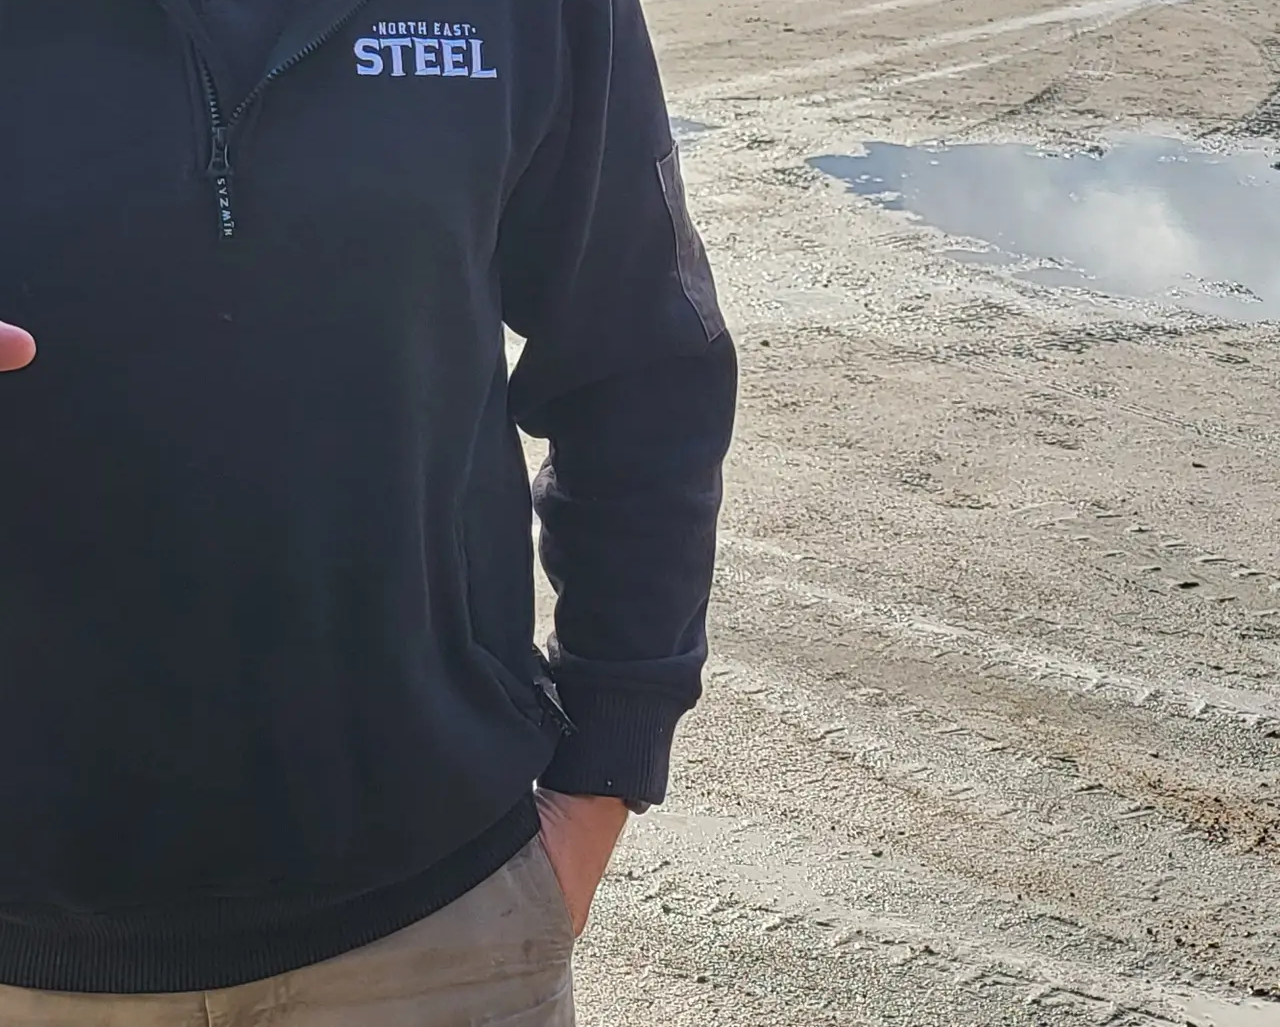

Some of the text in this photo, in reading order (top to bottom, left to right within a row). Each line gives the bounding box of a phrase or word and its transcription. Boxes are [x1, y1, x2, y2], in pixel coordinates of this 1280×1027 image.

[378, 21, 471, 36] NORTH EAST
[354, 36, 498, 79] STEEL
